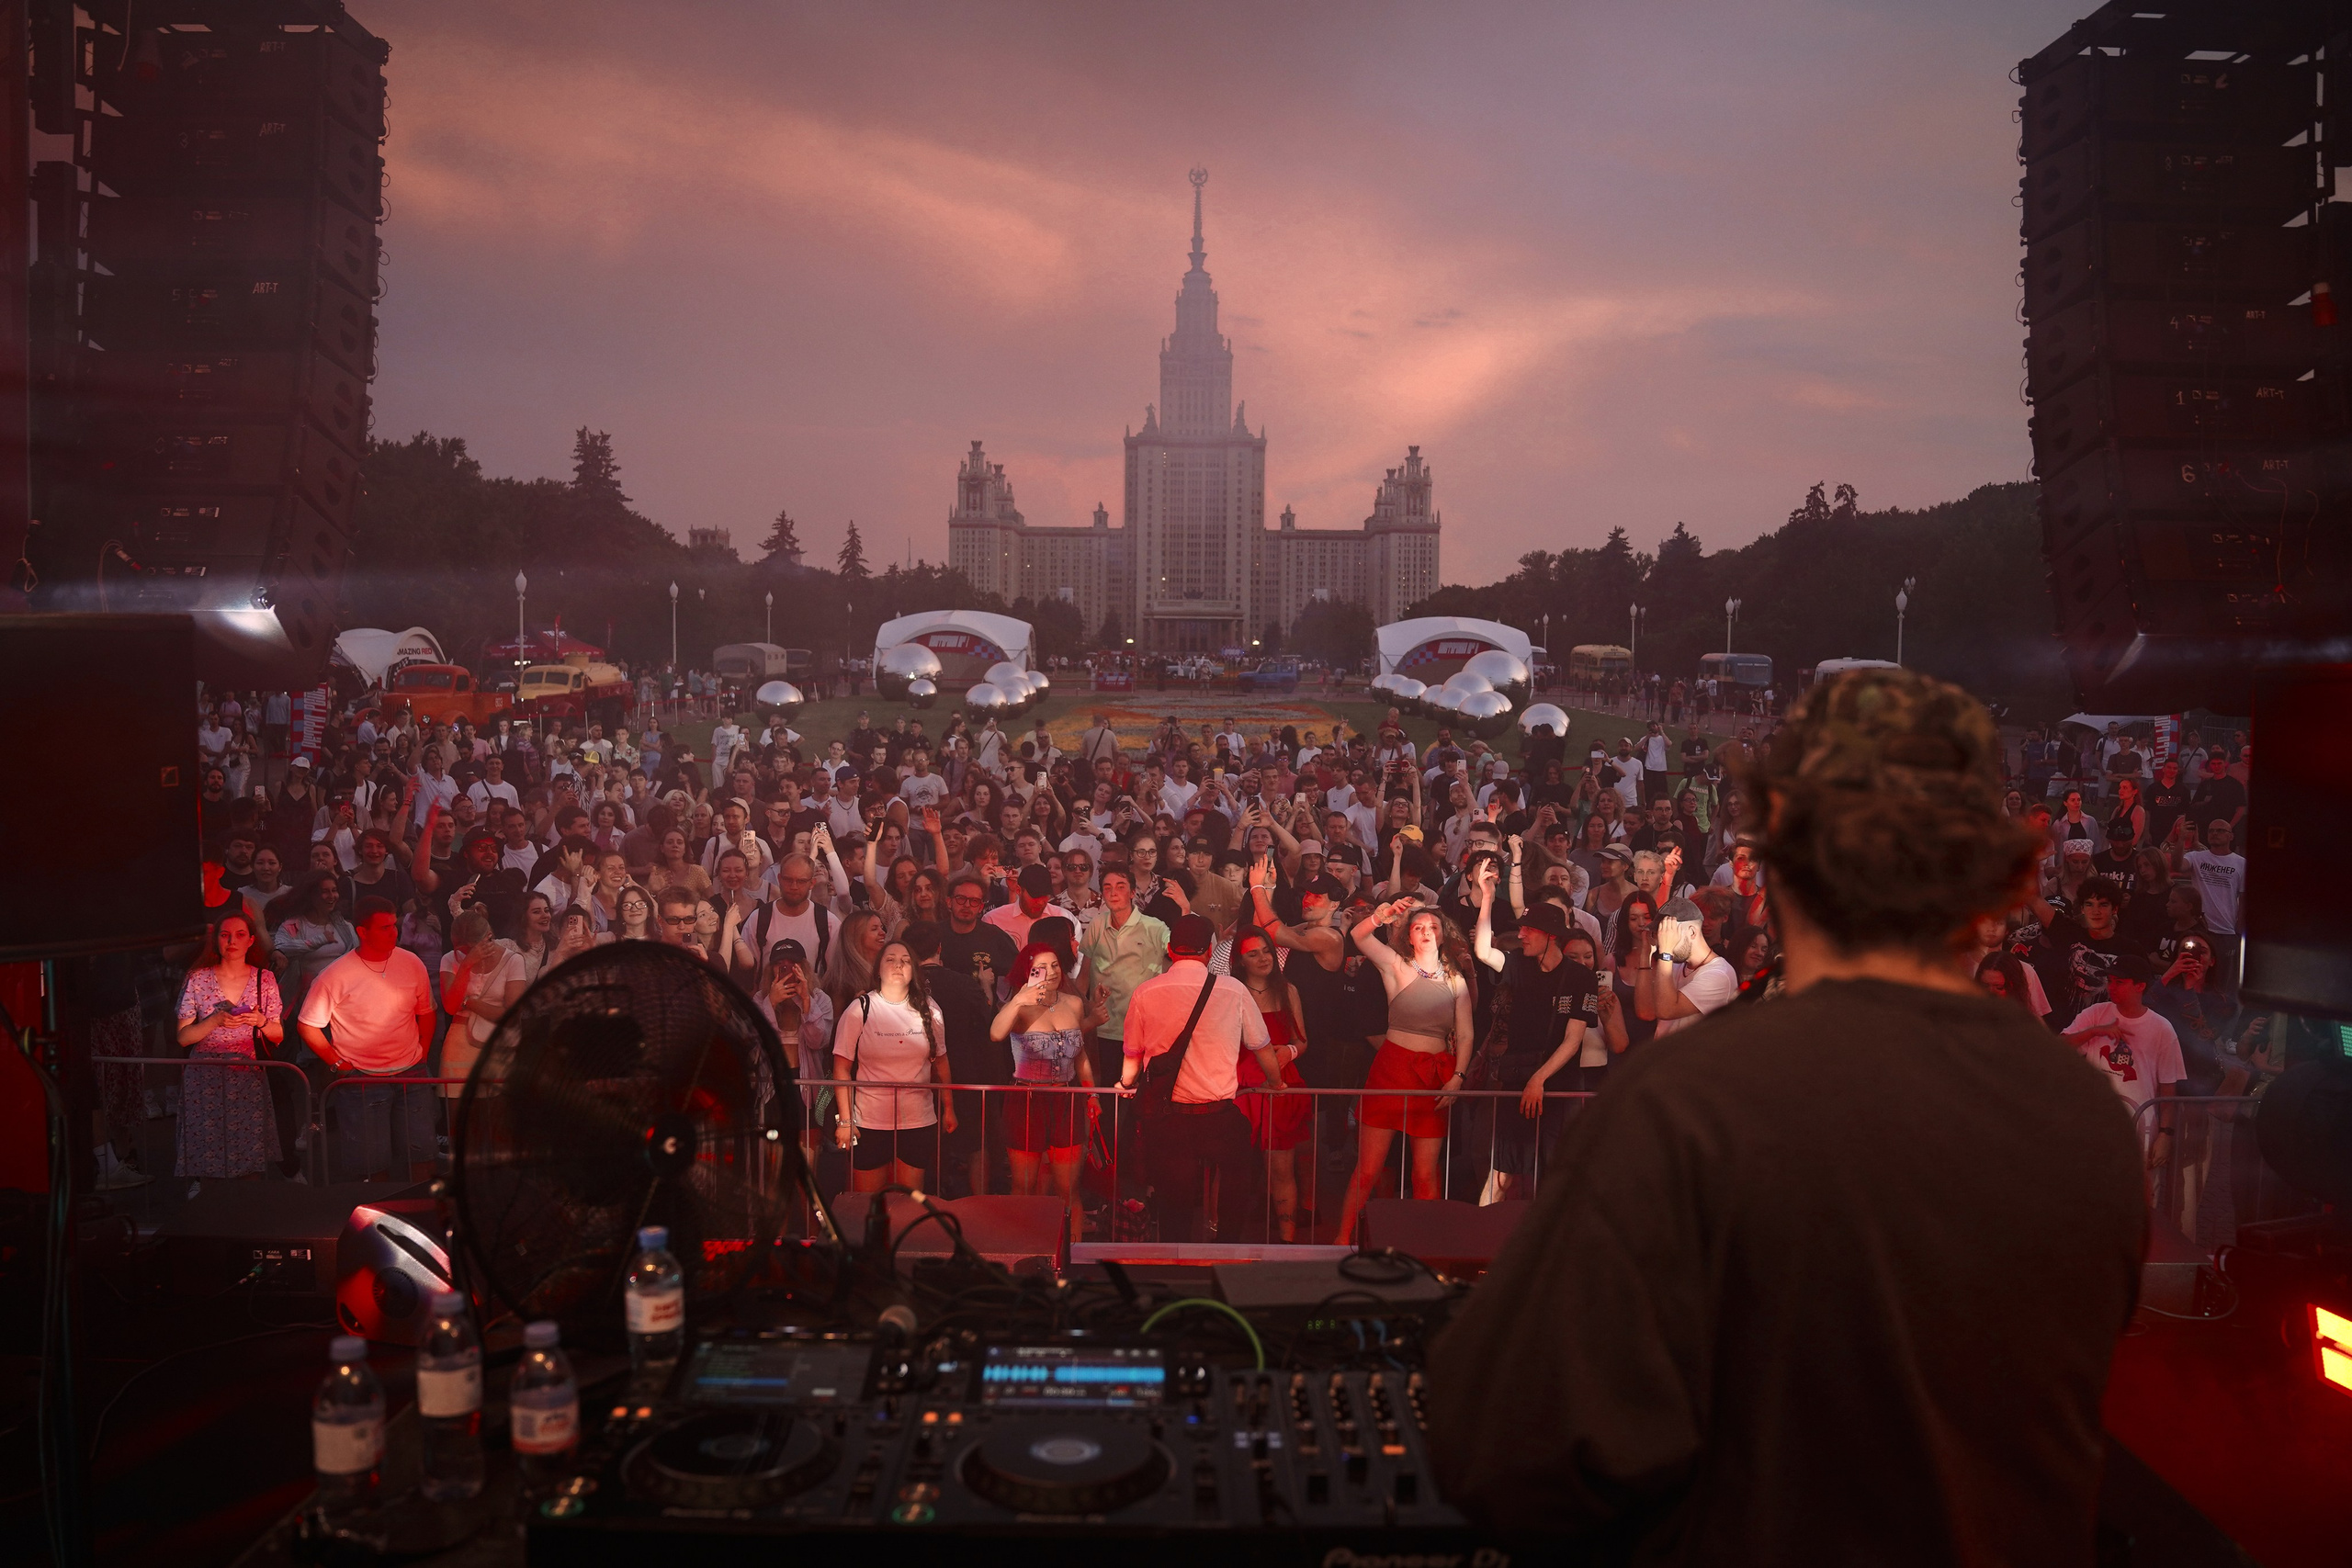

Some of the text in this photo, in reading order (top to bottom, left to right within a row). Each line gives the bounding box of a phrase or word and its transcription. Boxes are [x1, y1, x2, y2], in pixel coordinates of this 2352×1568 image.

[259, 122, 286, 137] ART-T
[252, 282, 280, 295] ART-T
[2245, 310, 2266, 320] ART-T
[2169, 316, 2178, 330] 4
[2176, 390, 2187, 405] 1
[2256, 387, 2285, 400] ART-T
[2262, 459, 2289, 470] ART-T
[2181, 463, 2196, 483] 6
[2199, 862, 2236, 875] ИНЖЕНЕР
